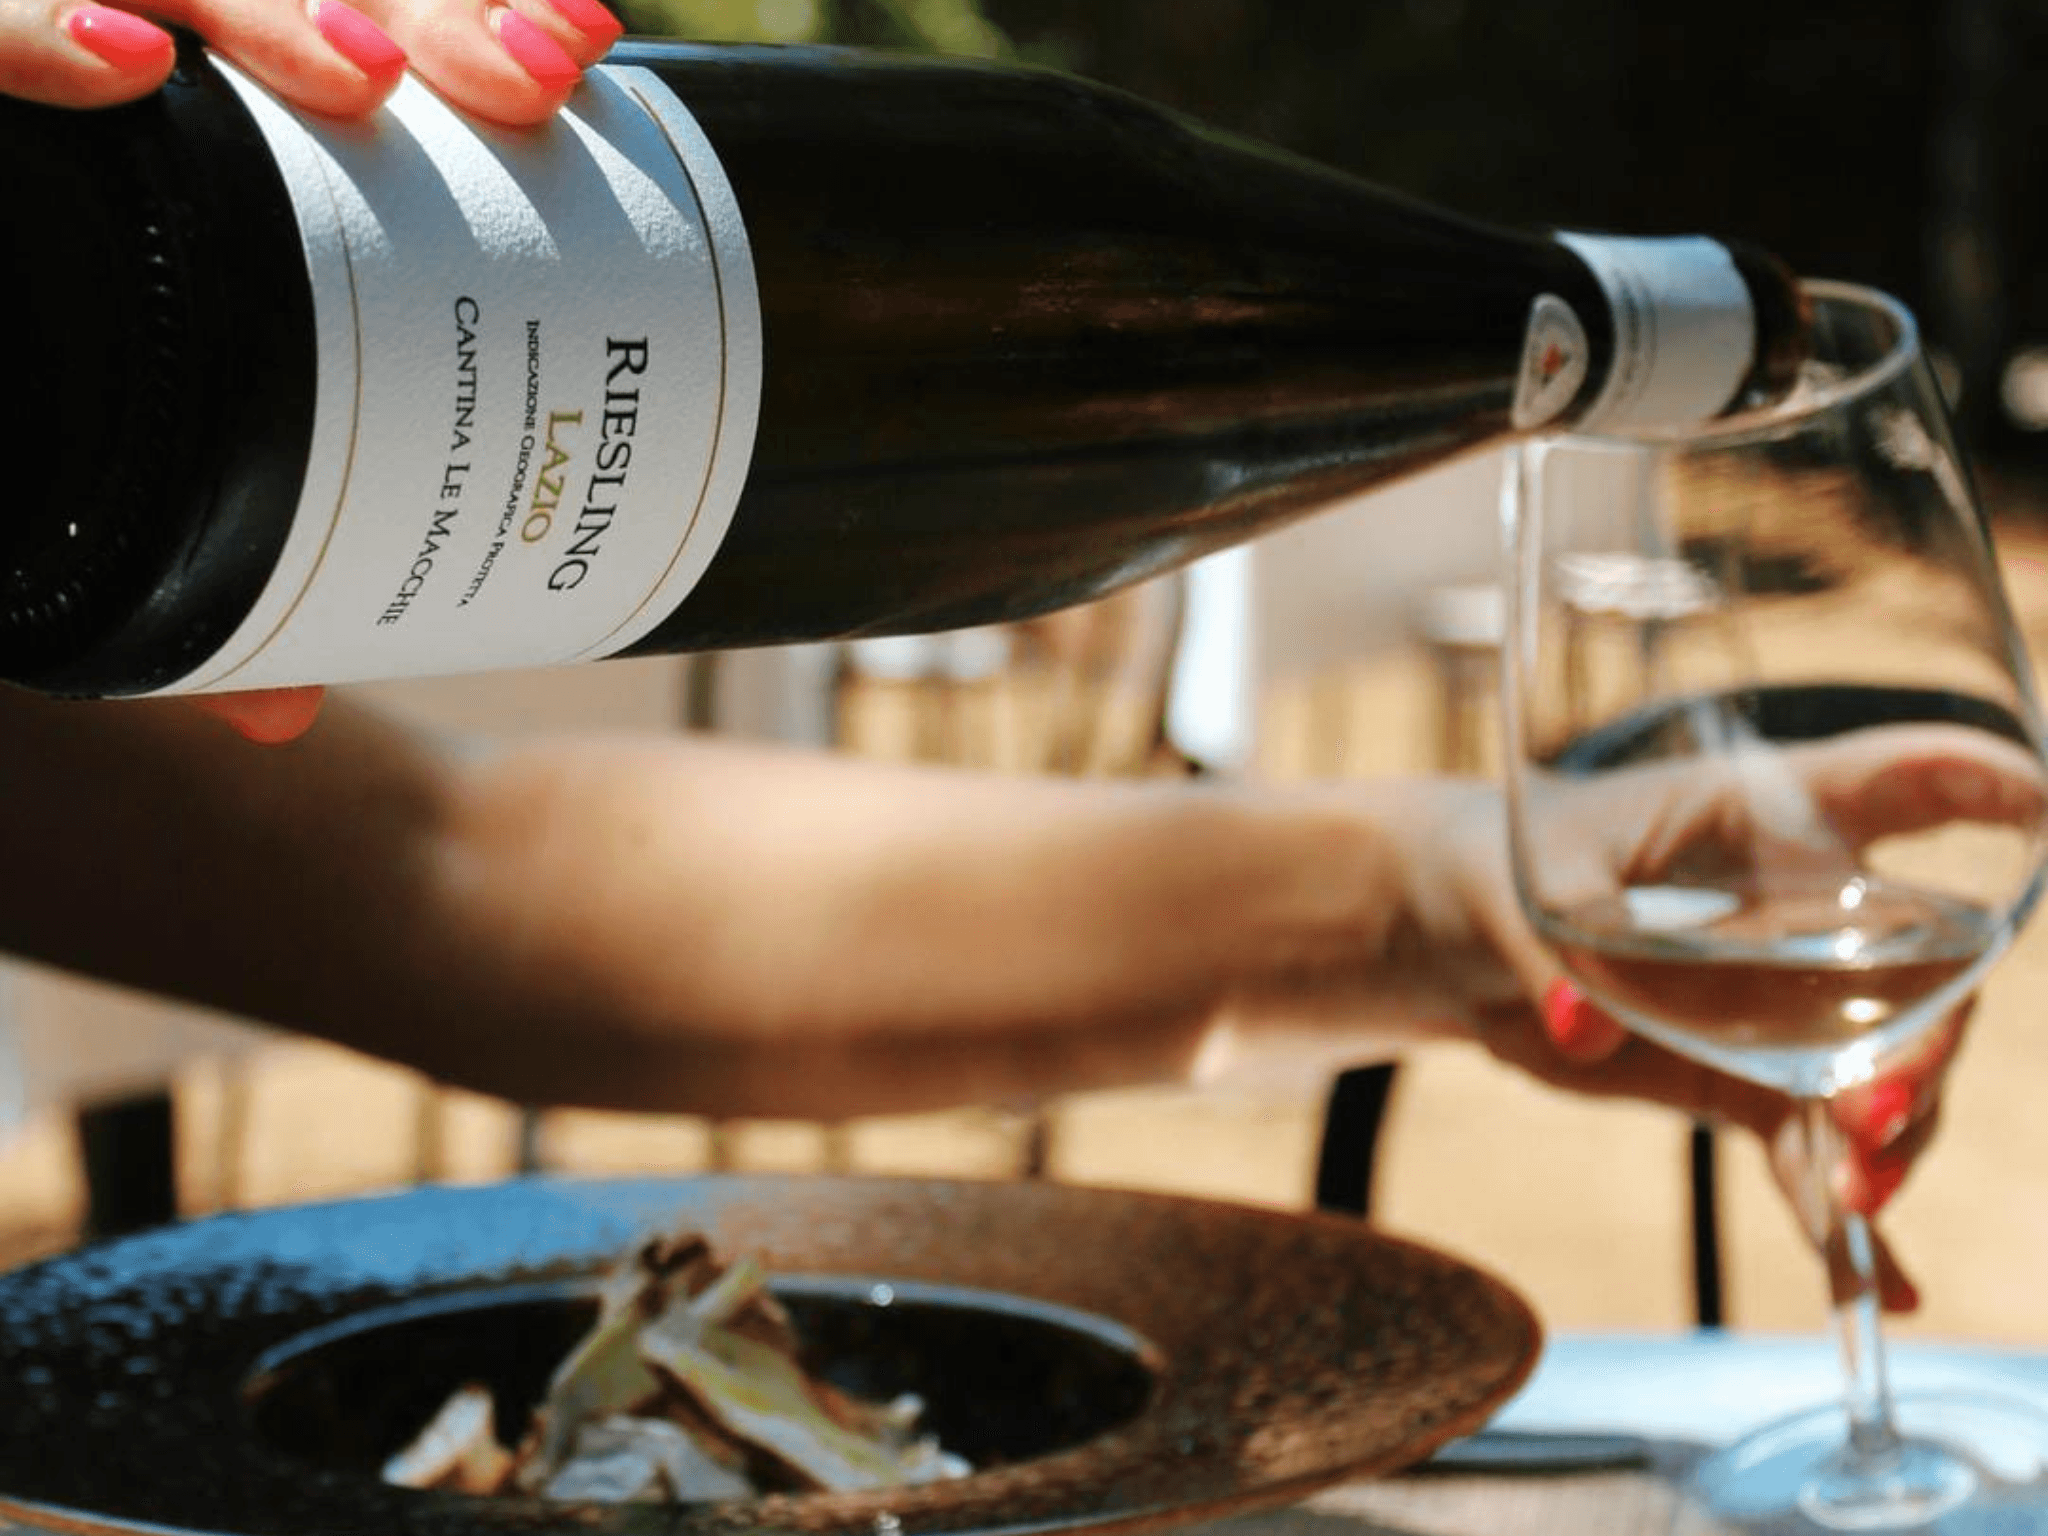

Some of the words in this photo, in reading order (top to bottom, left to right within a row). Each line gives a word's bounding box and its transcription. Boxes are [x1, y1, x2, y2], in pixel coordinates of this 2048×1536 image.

[452, 295, 480, 451] CANTINA
[526, 320, 540, 430] INDICAZIONE
[439, 462, 471, 500] LE
[497, 435, 536, 538] GEOGRAFICA
[520, 410, 584, 544] LAZIO
[547, 336, 649, 592] RIESLING
[376, 508, 459, 627] MACCHIE
[457, 541, 505, 609] PROTETTA
